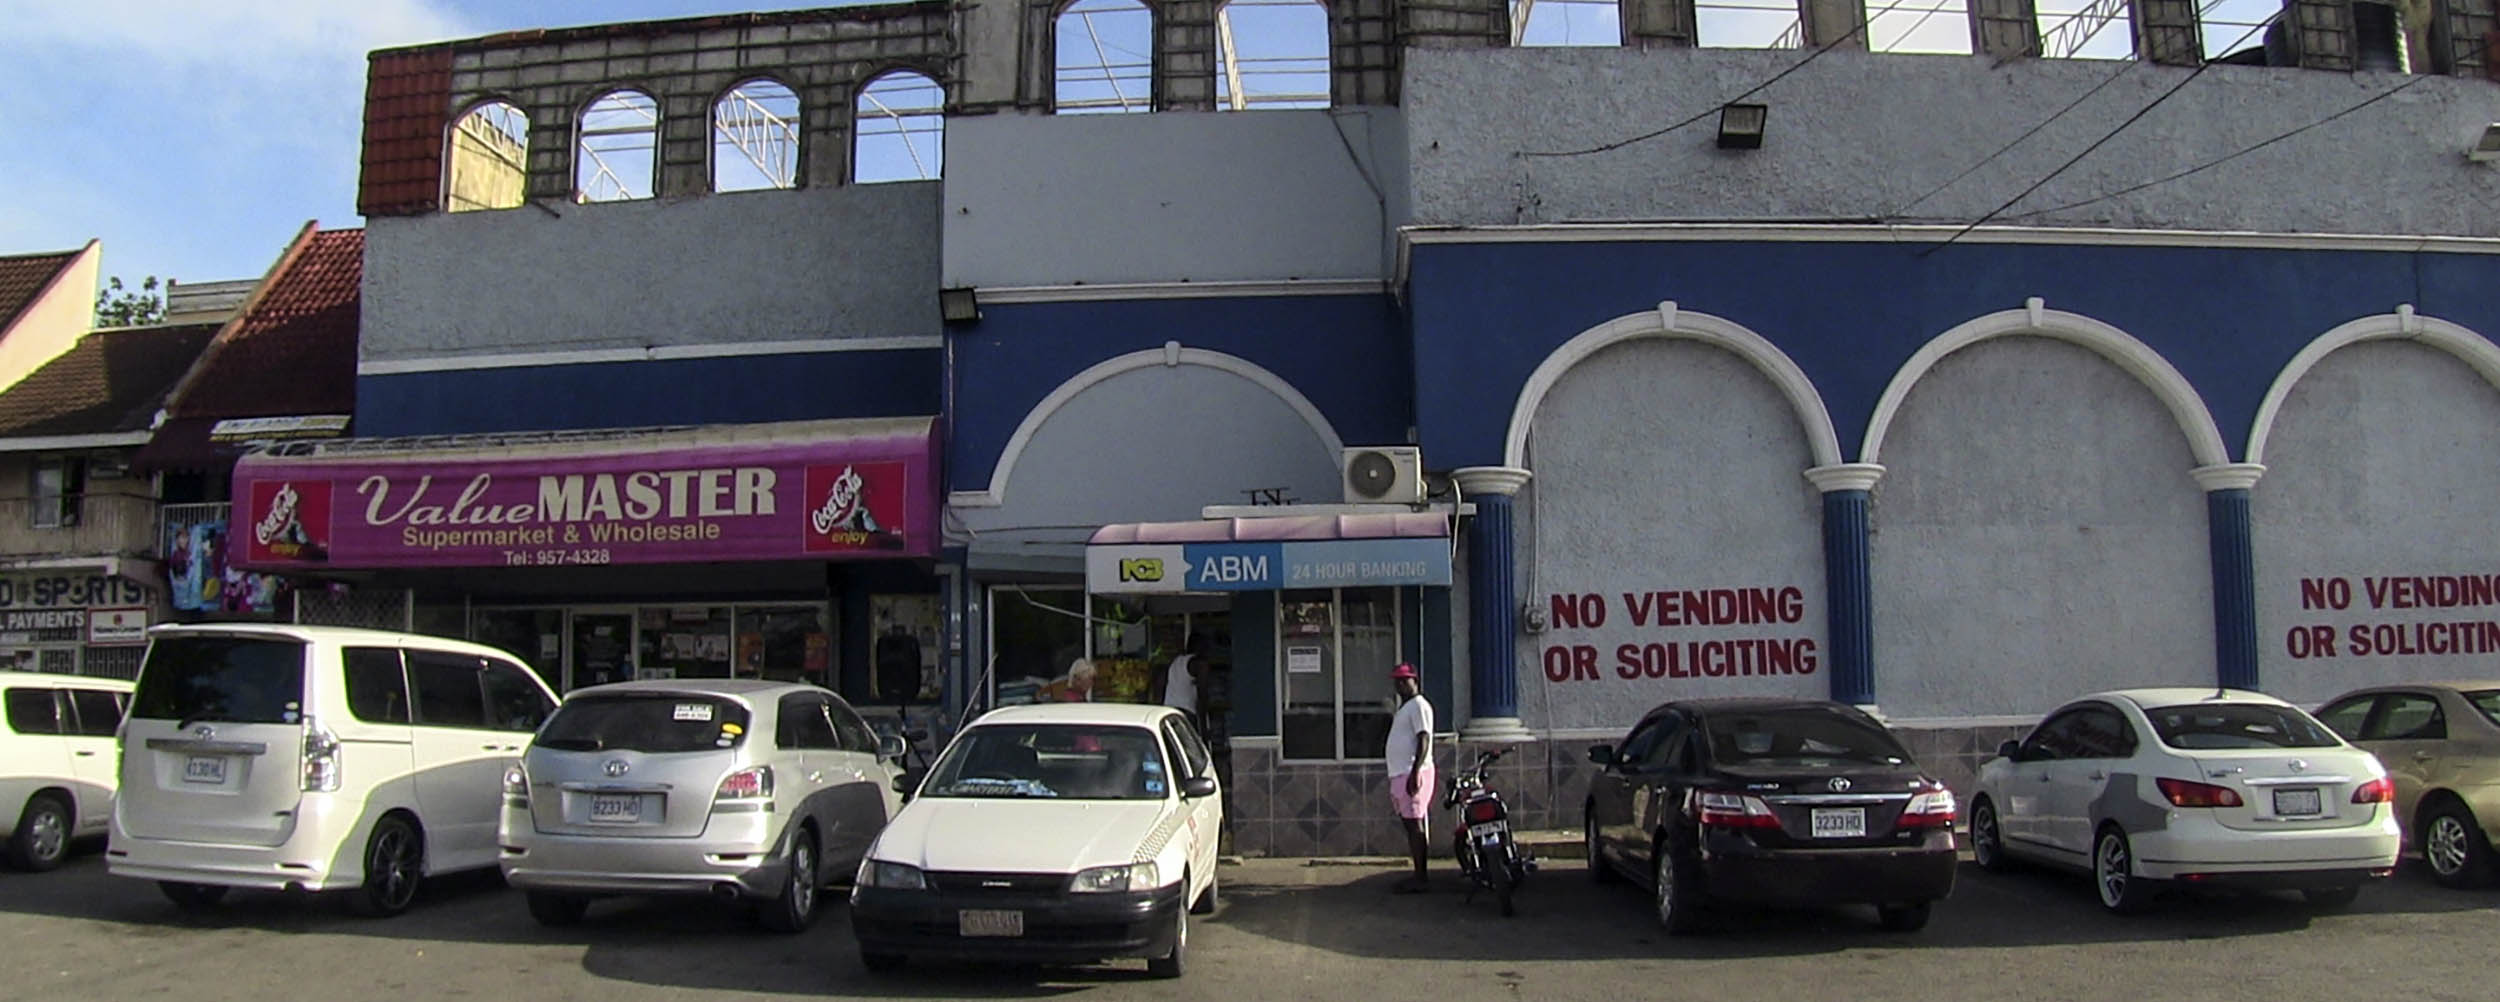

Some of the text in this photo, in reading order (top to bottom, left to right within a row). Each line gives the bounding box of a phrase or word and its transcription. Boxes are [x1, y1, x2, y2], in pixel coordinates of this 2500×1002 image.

[357, 467, 777, 525] Value MASTER
[403, 520, 721, 550] Supermarket & Wholesale
[504, 549, 610, 565] Tel: 957-4328
[1119, 558, 1164, 582] NCB
[1200, 555, 1268, 582] ABM
[1293, 560, 1426, 580] 24 HOUR BANKING
[34, 575, 141, 606] SPORTS
[2301, 577, 2351, 610] NO
[7, 611, 85, 630] PAYMENTS
[1551, 586, 1803, 629] NO VENDING
[2287, 625, 2336, 659] OR
[1544, 638, 1816, 682] OR SOLICITING
